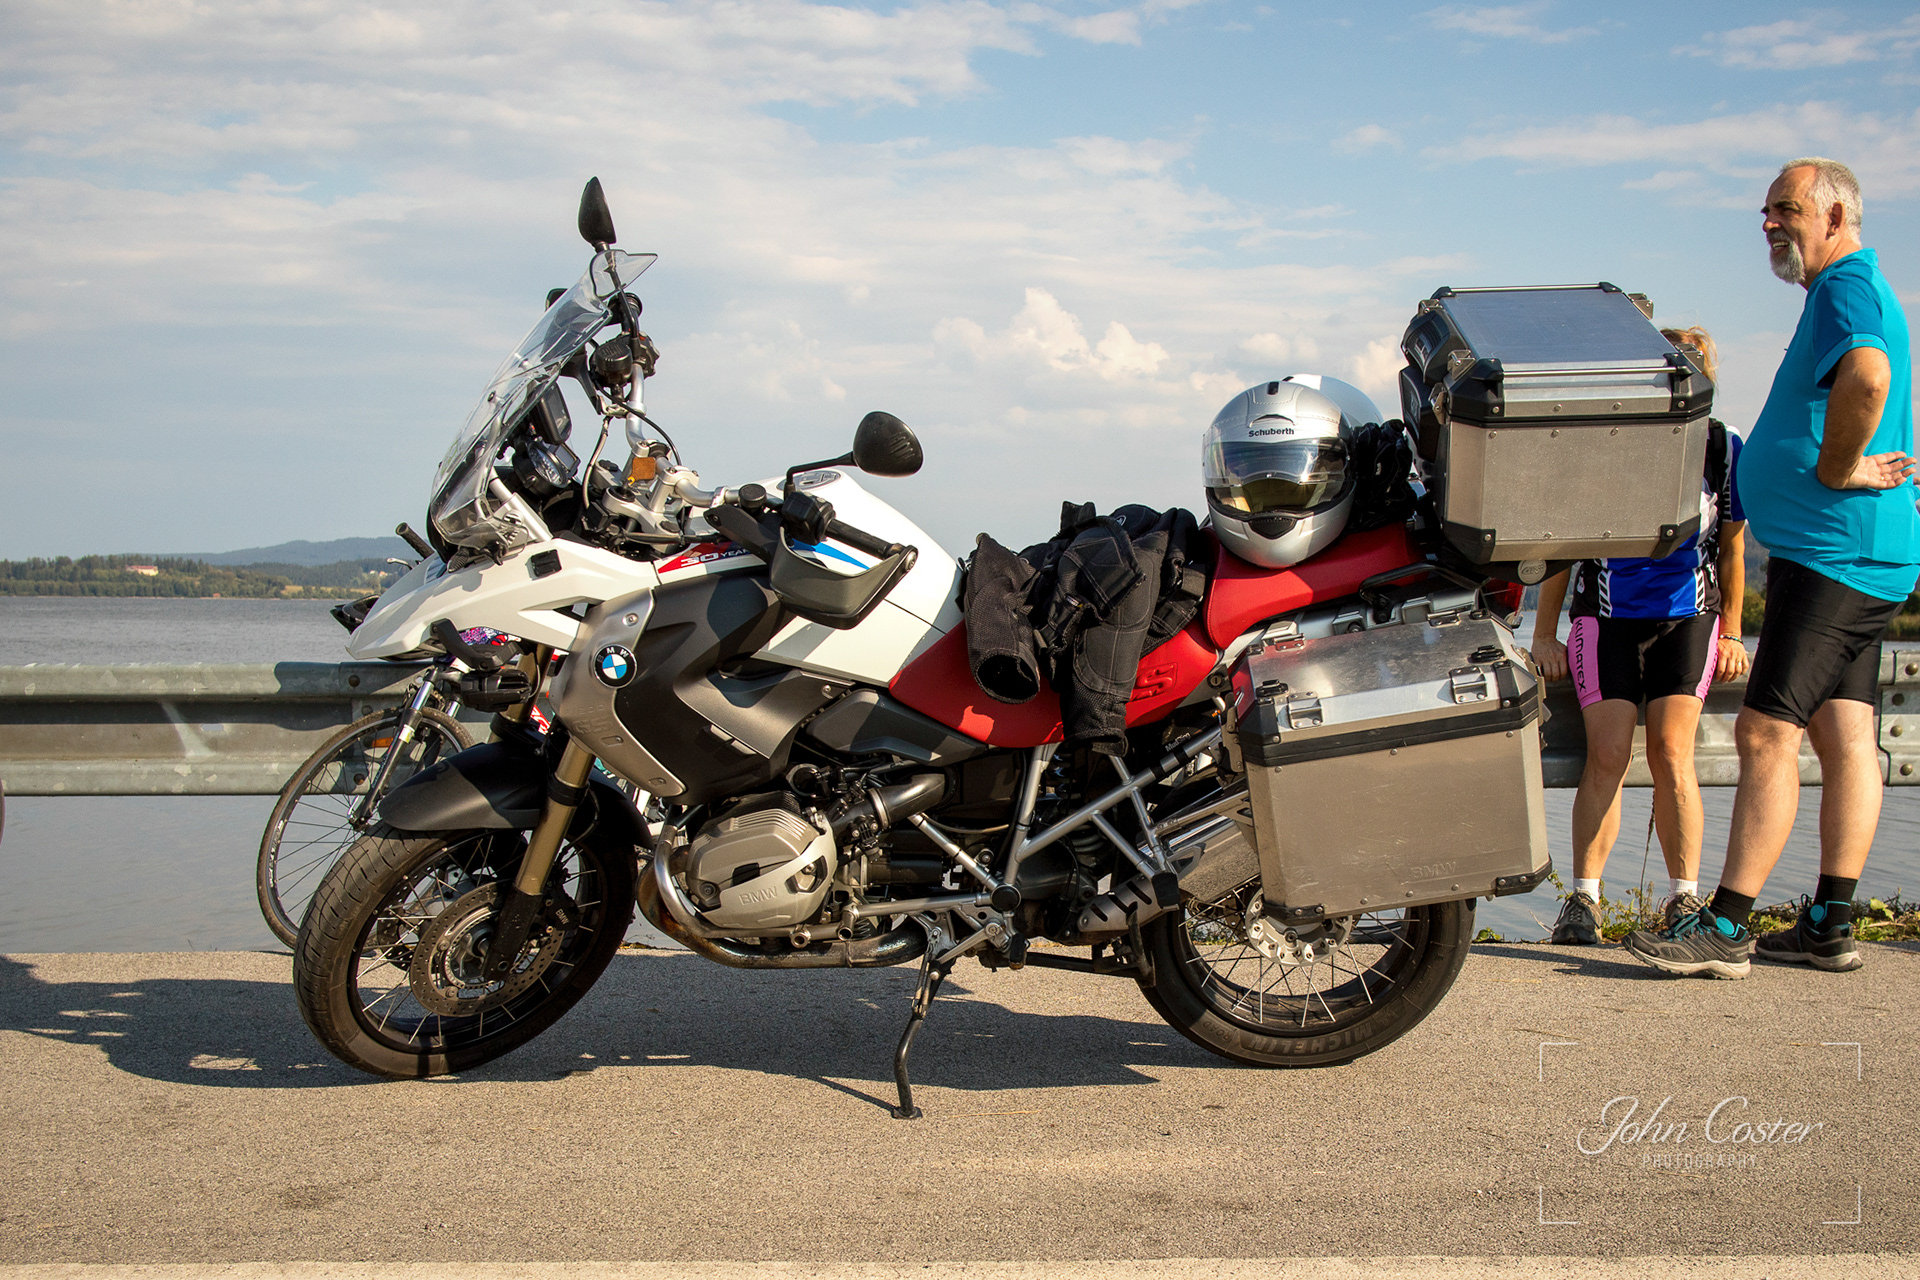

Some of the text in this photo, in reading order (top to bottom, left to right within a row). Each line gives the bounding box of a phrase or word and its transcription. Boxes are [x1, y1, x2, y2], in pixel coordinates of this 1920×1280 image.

[1248, 427, 1295, 438] Schuberth
[681, 552, 719, 567] 30
[596, 646, 630, 662] BMW
[1575, 618, 1588, 691] KLIMATEX
[1410, 861, 1457, 878] BMW
[739, 886, 778, 906] BMW
[1251, 1022, 1374, 1055] MICHELIN
